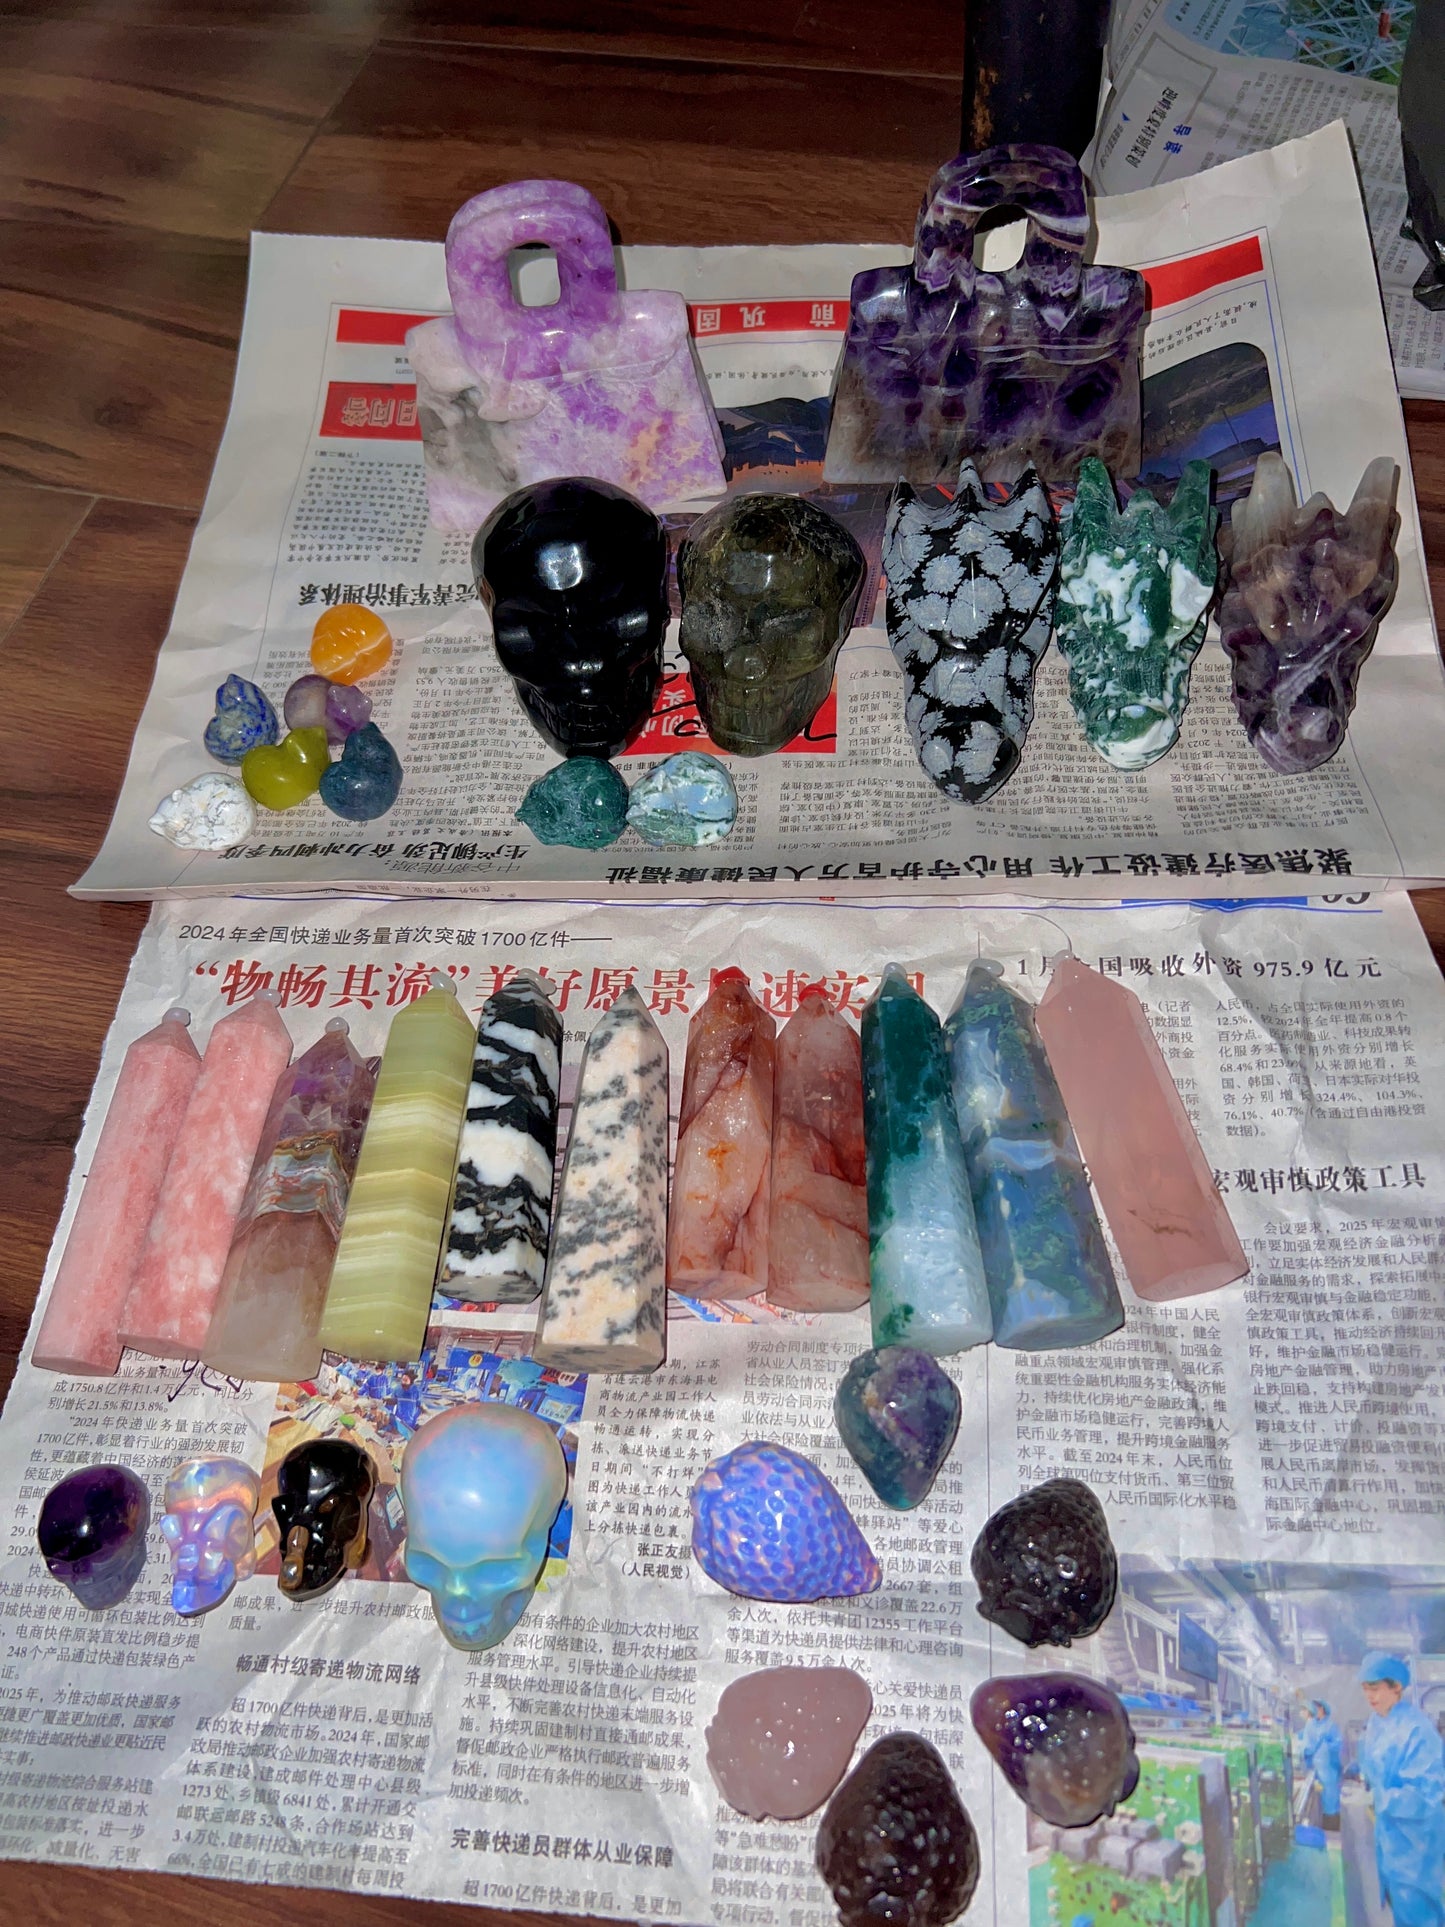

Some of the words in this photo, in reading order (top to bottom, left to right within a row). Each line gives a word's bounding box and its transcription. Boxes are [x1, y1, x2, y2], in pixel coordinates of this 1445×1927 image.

[1125, 87, 1178, 168] 迎峰度夏特别策划
[809, 304, 835, 328] 前
[298, 582, 479, 607] 完善军事治理体系
[604, 856, 1033, 884] 用心守护百万人民健康福祉
[1018, 952, 1383, 978] 1月国吸收外资975.9亿元
[1251, 1362, 1445, 1378] 房地产金融管理，助力房地产
[600, 1388, 717, 1403] 商物流产业园工作人
[1253, 1381, 1445, 1397] 止跌回稳，支持构建房地产发
[597, 1405, 716, 1423] 员全力保障物流快递
[637, 1542, 692, 1560] 张正友摄
[874, 1535, 963, 1556] 各地邮政管理
[236, 1653, 421, 1685] 畅通村级寄递物流网络
[451, 1827, 675, 1868] 完善快递员群体从业保障
